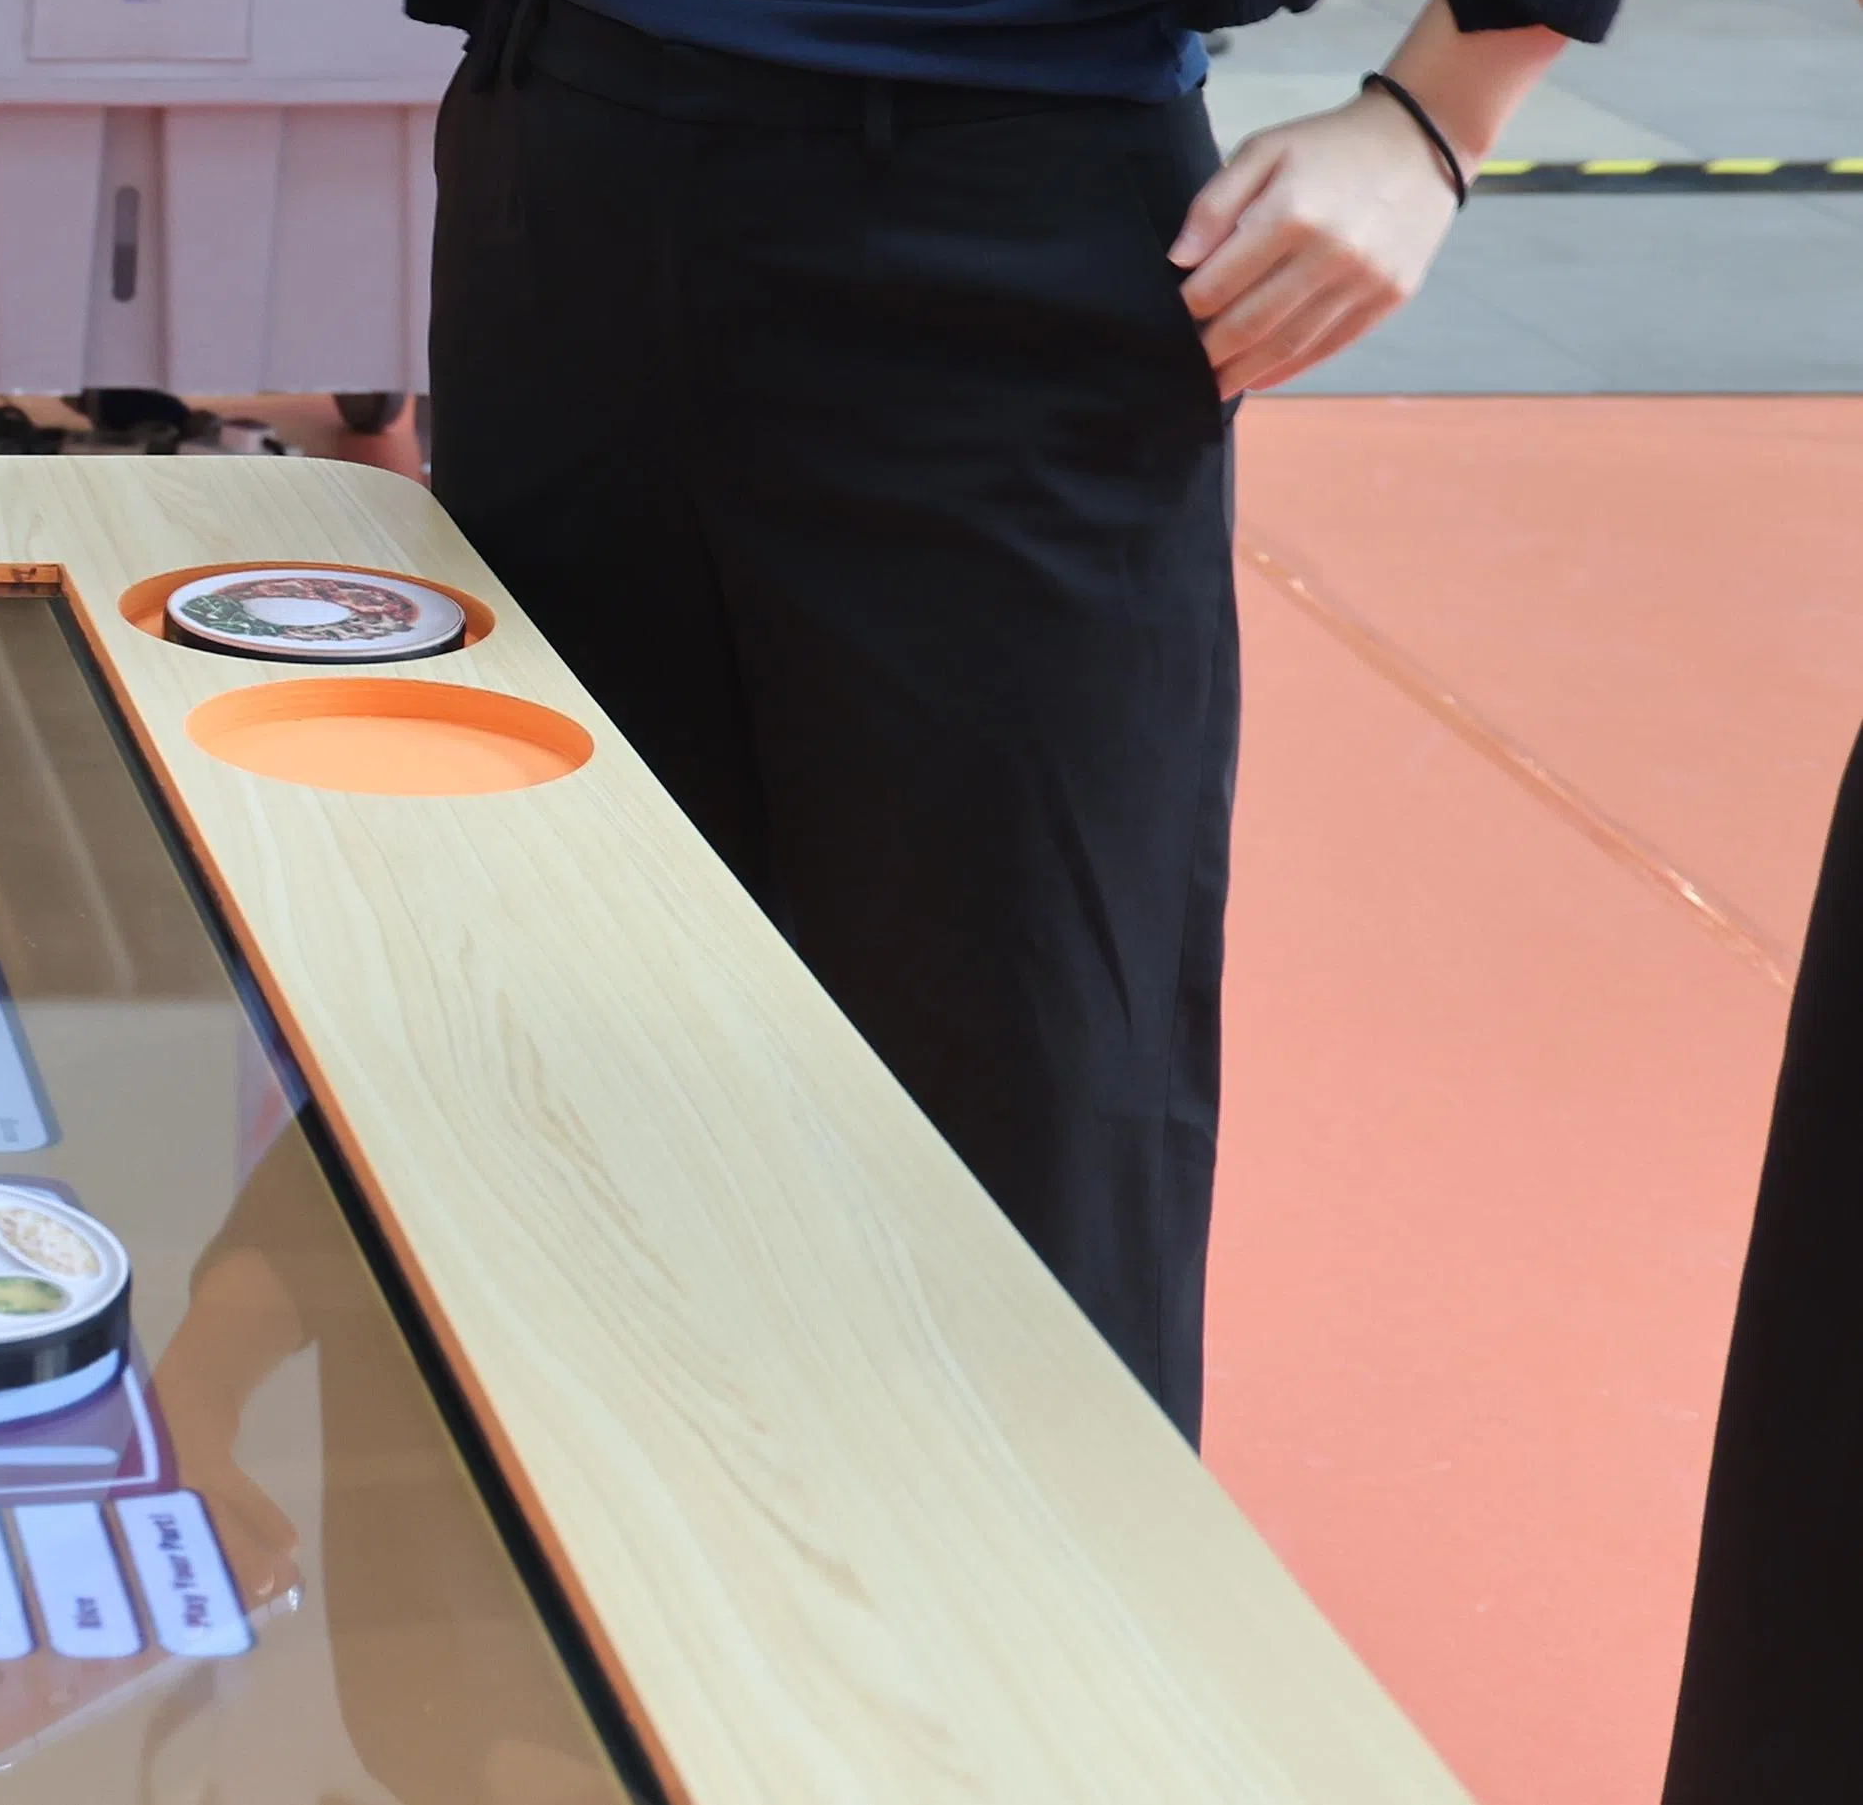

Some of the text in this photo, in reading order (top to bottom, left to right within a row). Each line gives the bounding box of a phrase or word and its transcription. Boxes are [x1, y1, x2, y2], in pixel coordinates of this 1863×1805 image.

[149, 1512, 214, 1629] Play Your Part!
[74, 1597, 103, 1629] Rice
